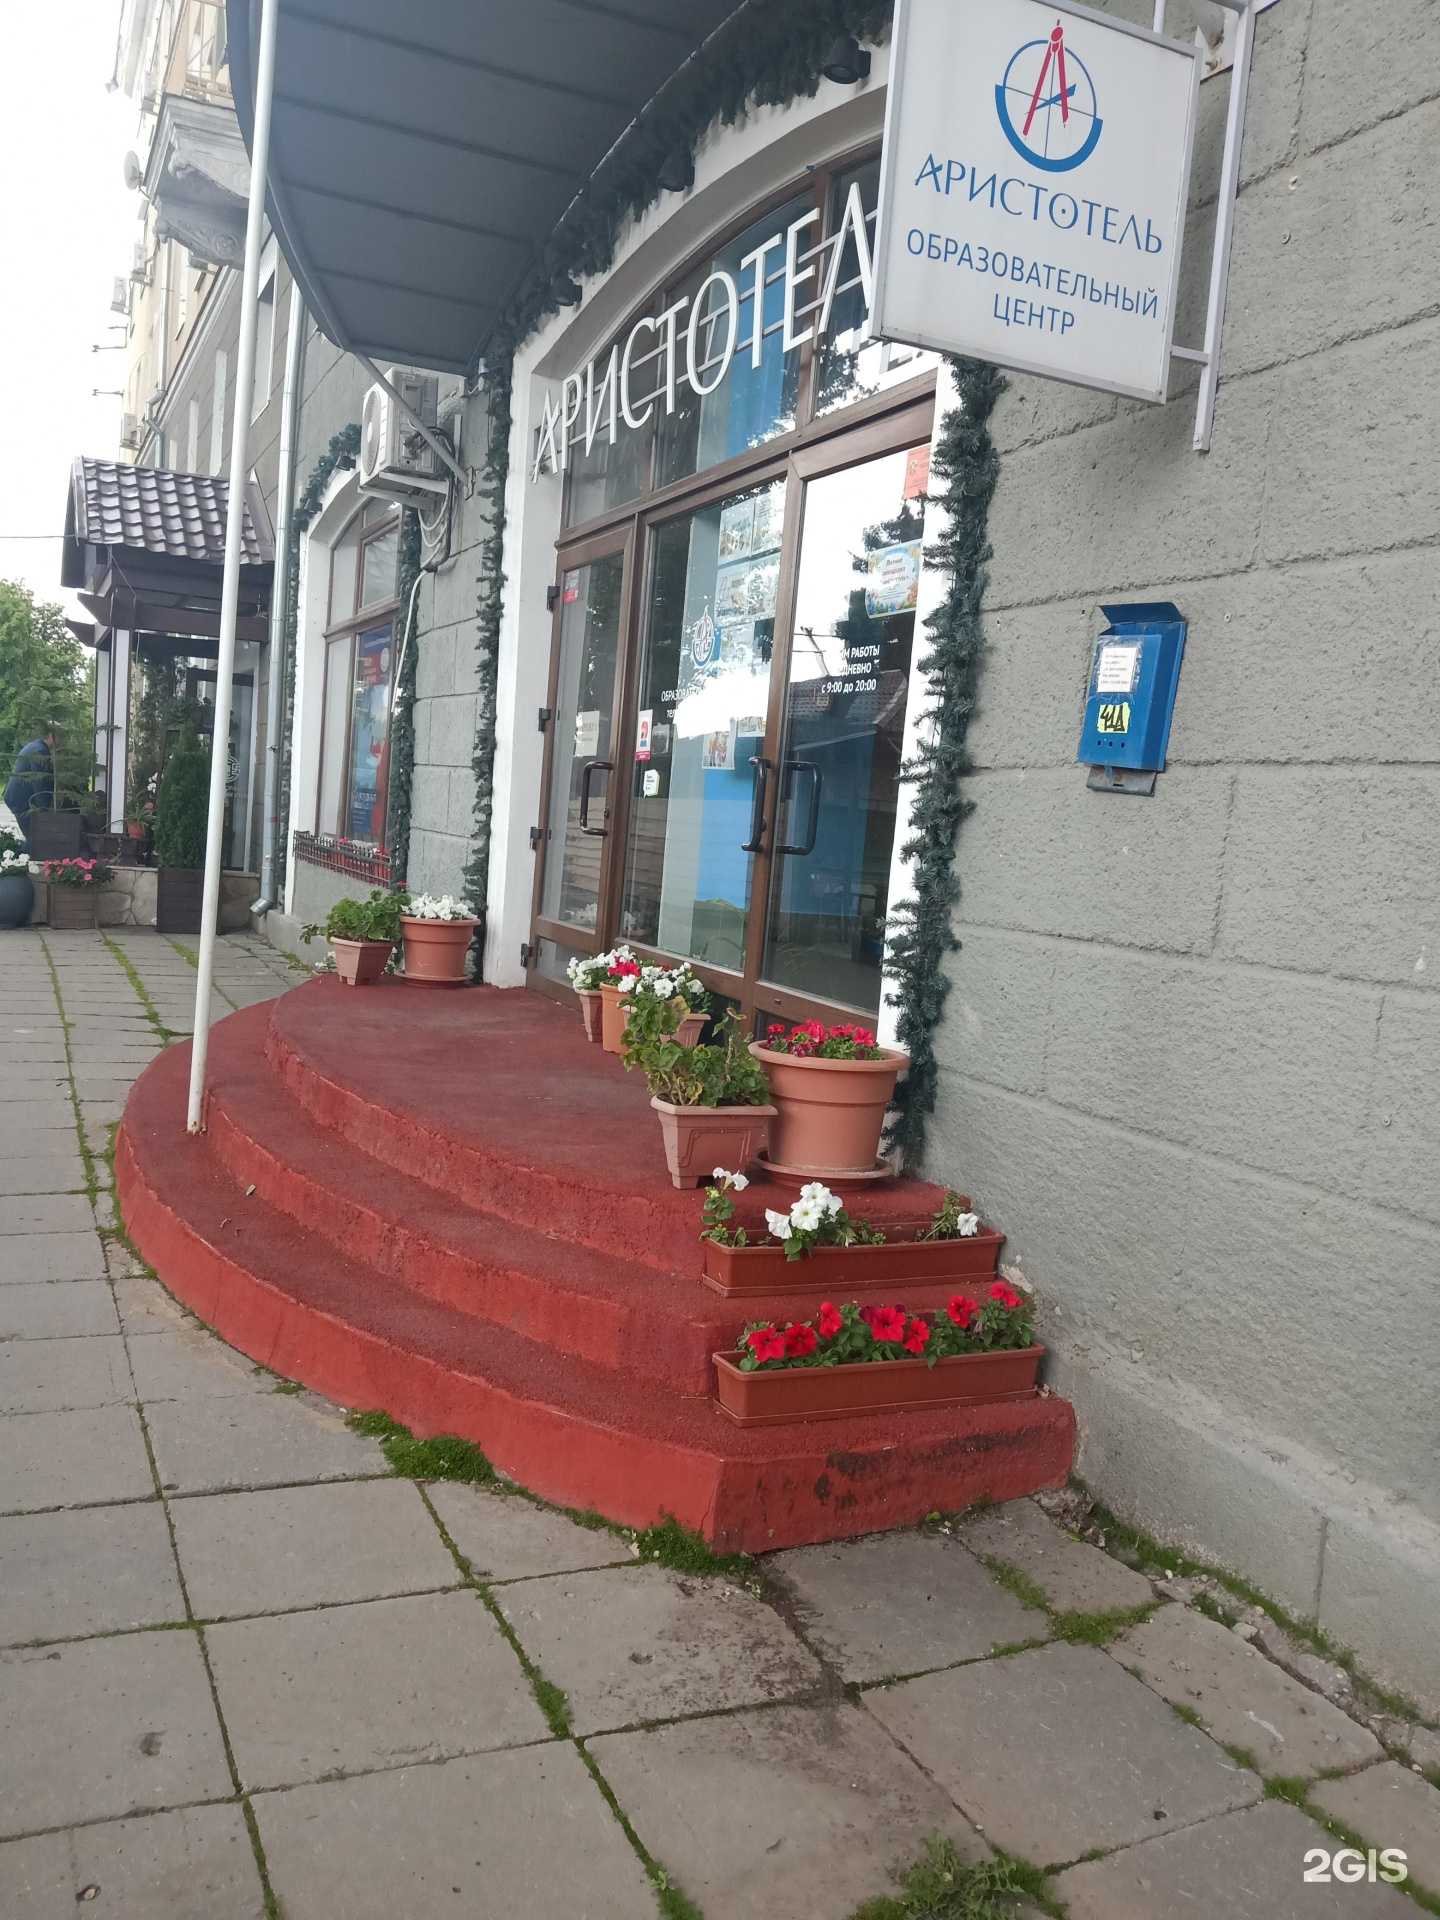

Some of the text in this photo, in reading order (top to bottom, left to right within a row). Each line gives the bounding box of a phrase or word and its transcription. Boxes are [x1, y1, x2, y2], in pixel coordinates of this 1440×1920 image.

[914, 153, 1162, 254] АРИСТОТЕЛЬ
[907, 229, 1159, 318] ОБРАЗОВАТЕЛЬНЫЙ
[531, 182, 873, 484] АРИСТОТЕЛ
[993, 294, 1075, 335] ЦЕНТР
[851, 645, 880, 658] РАБОТЫ
[827, 681, 843, 693] 9:00
[843, 683, 853, 694] до
[855, 678, 877, 692] 20:00
